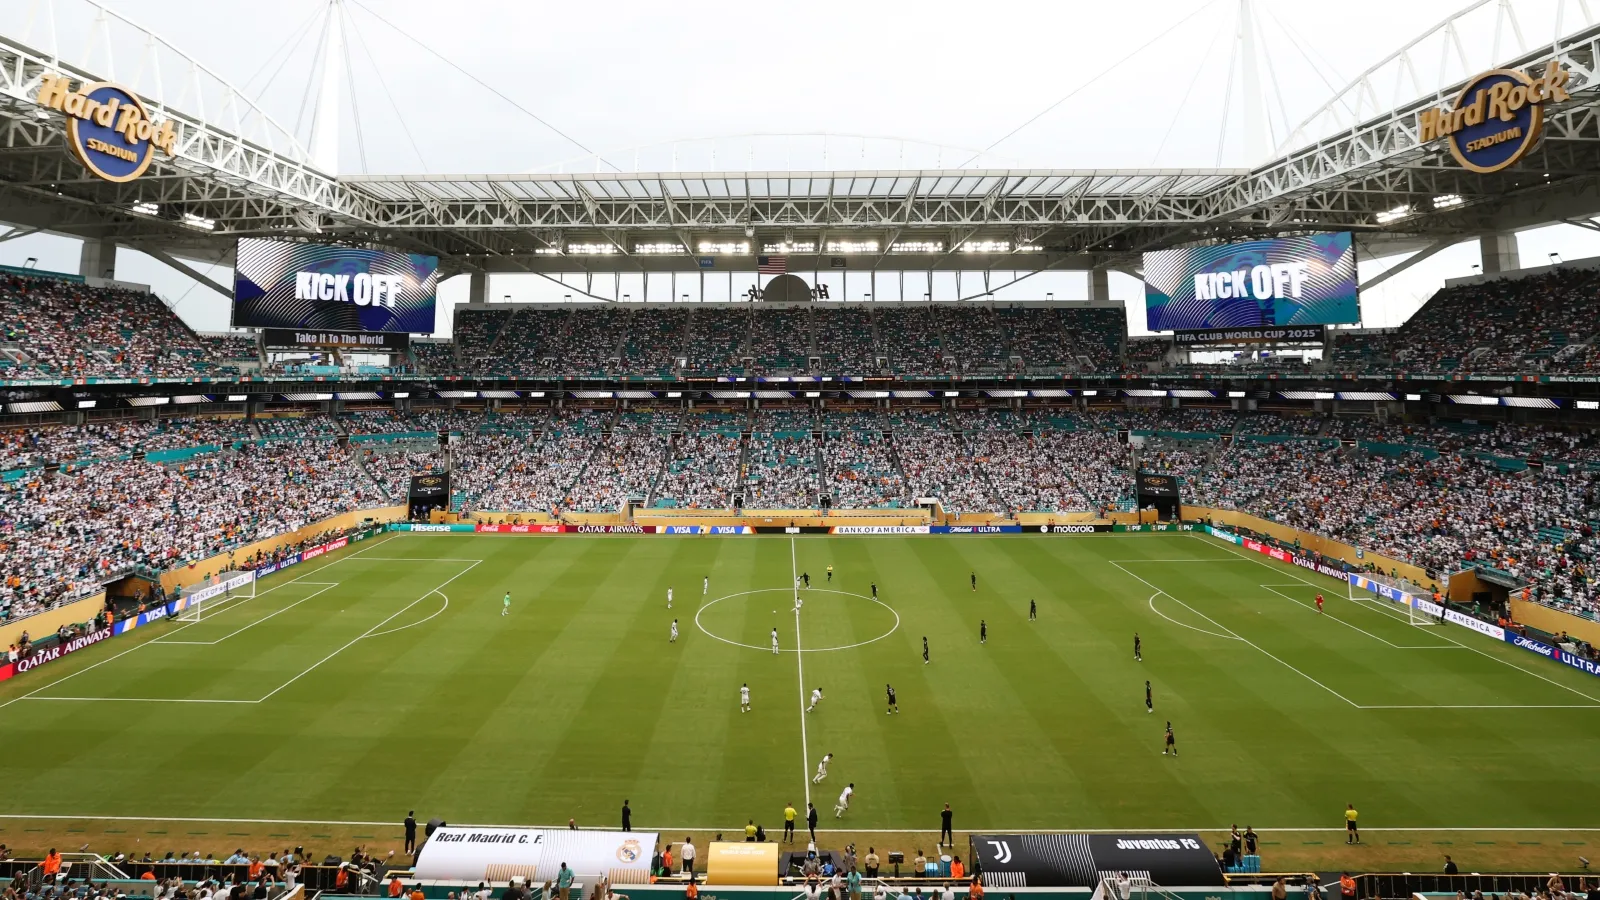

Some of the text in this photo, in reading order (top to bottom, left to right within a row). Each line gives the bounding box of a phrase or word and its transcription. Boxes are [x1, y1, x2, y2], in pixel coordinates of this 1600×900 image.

[1420, 61, 1570, 143] Hard Rock
[37, 74, 177, 157] Hard Rock
[1466, 127, 1521, 152] STADIUM
[87, 138, 138, 162] STADIUM
[1194, 261, 1309, 301] KICK OFF
[295, 271, 404, 308] KICK OFF
[295, 332, 384, 345] Take It To The World
[1176, 334, 1195, 342] FIFA
[1198, 332, 1223, 341] CLUB
[1225, 331, 1262, 340] WORLD
[1264, 330, 1285, 339] CUP
[410, 524, 451, 532] Hisense
[673, 526, 691, 534] VISA
[717, 526, 735, 534] VISA
[1053, 525, 1095, 533] motorola
[1211, 528, 1237, 544] Hisense
[304, 547, 324, 560] Lenovo
[326, 539, 346, 552] Lenovo
[280, 557, 298, 569] ULTRA
[1292, 556, 1348, 581] QATAR AIRWAYS
[144, 606, 167, 622] VISA
[1452, 613, 1491, 633] AMERICA
[17, 626, 111, 672] QATAR AIRWAYS
[1513, 636, 1600, 677] Michelob ULTRA
[435, 832, 543, 844] Real Madrid C. F.
[1116, 838, 1200, 850] Juventus FC
